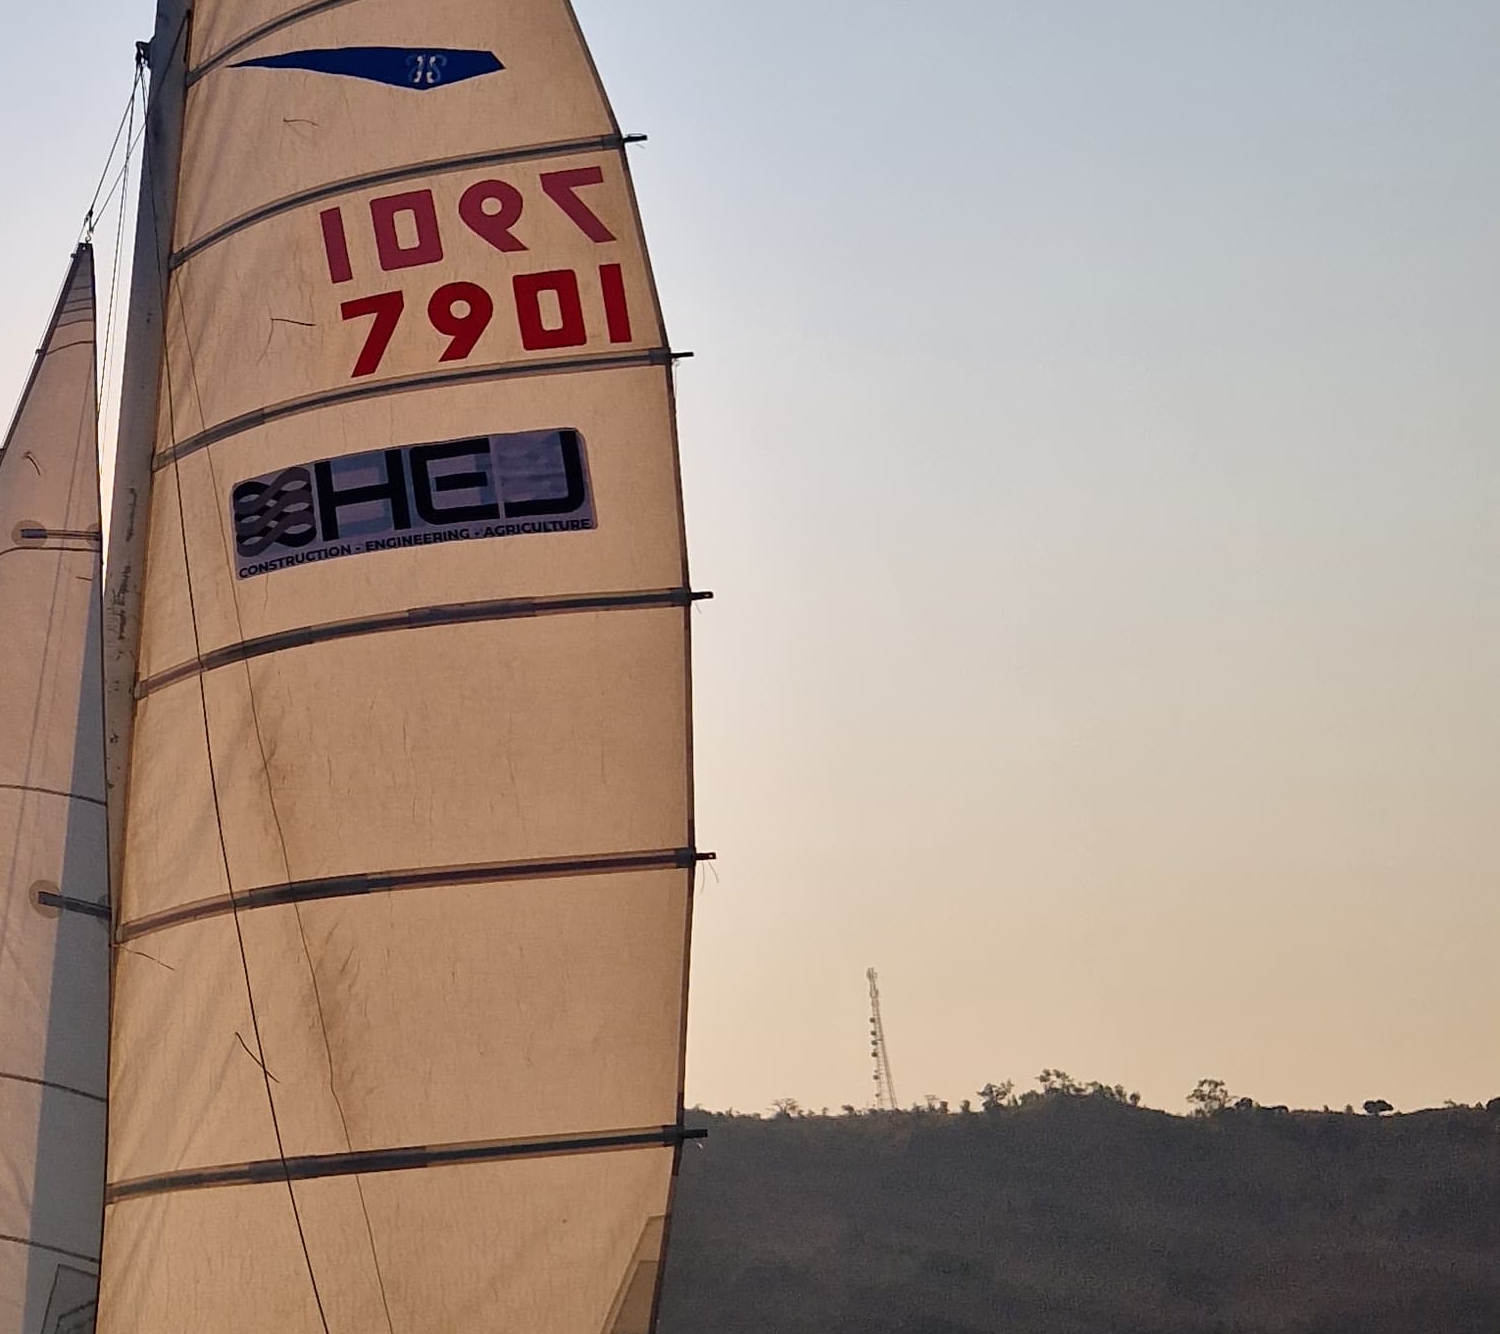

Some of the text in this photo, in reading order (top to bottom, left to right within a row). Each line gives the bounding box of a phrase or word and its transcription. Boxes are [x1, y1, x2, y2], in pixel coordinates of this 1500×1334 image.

[340, 263, 633, 379] 7901
[314, 430, 586, 542] HEJ
[238, 543, 352, 579] CONSTRUCTION
[365, 527, 471, 553] ENGINEERING
[483, 517, 592, 538] AGRICULTURE
